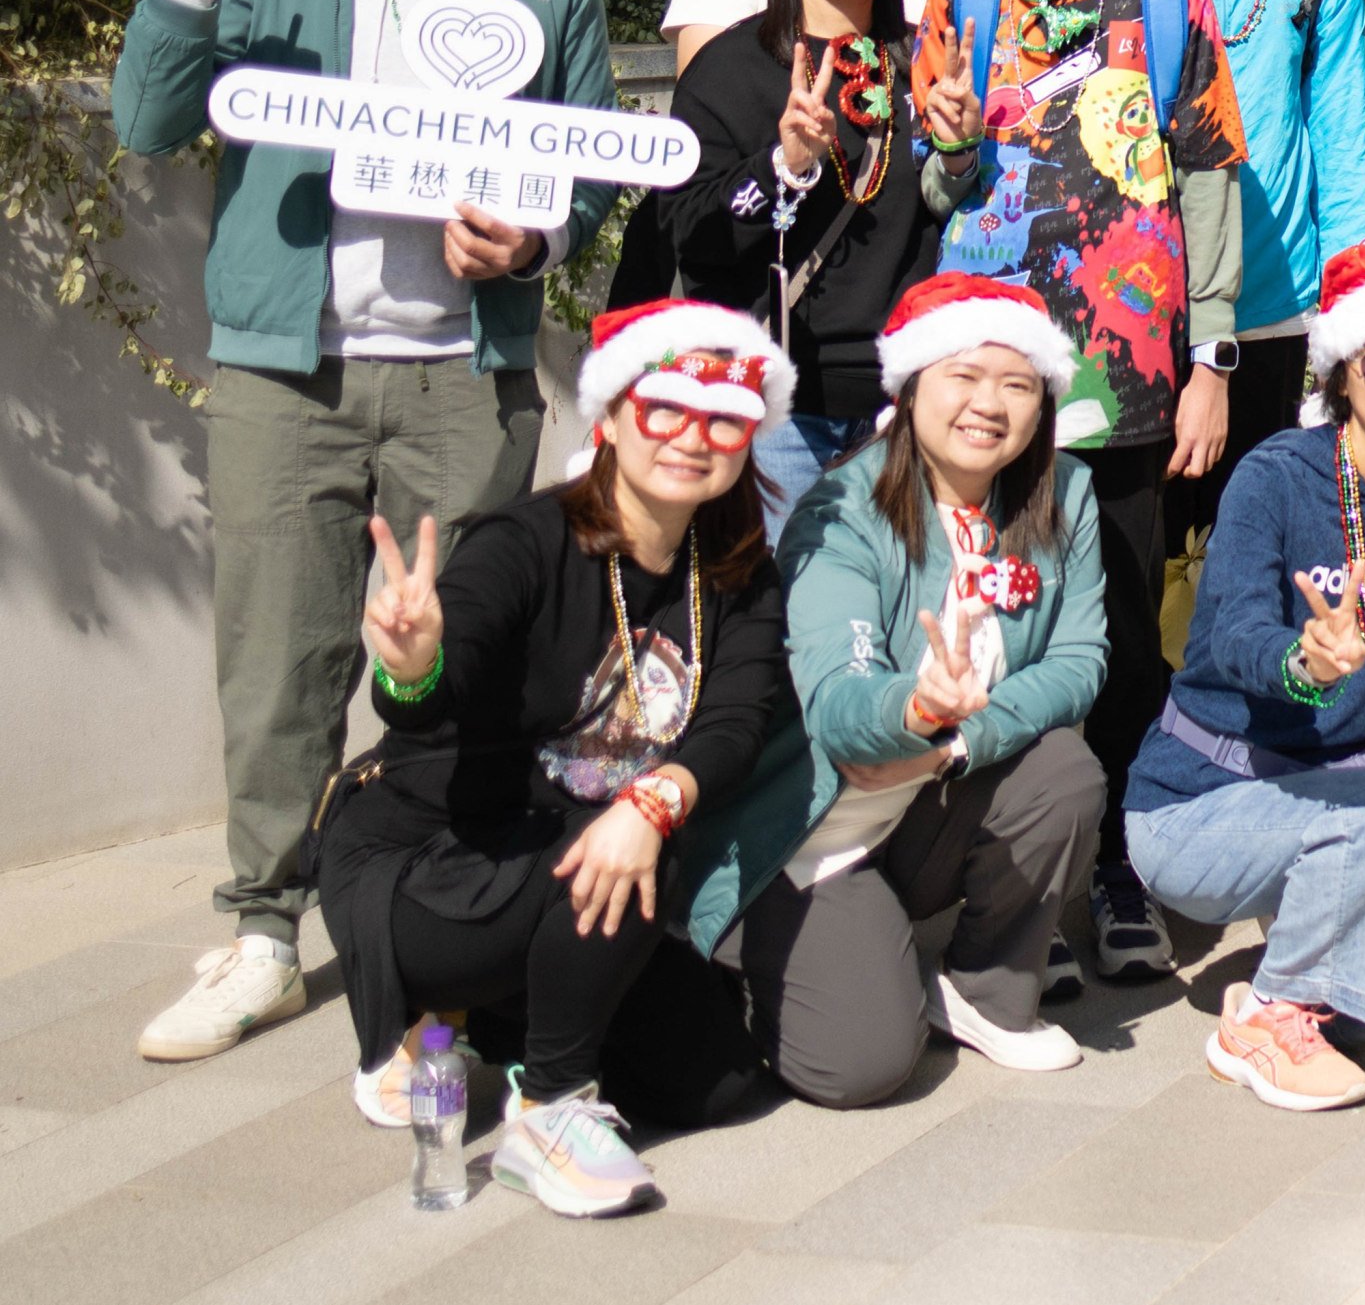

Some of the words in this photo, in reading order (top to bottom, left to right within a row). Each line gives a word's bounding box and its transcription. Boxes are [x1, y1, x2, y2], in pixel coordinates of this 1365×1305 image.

[227, 87, 512, 149] CHINACHEM
[529, 122, 686, 167] GROUP
[353, 153, 556, 212] 華懋集團
